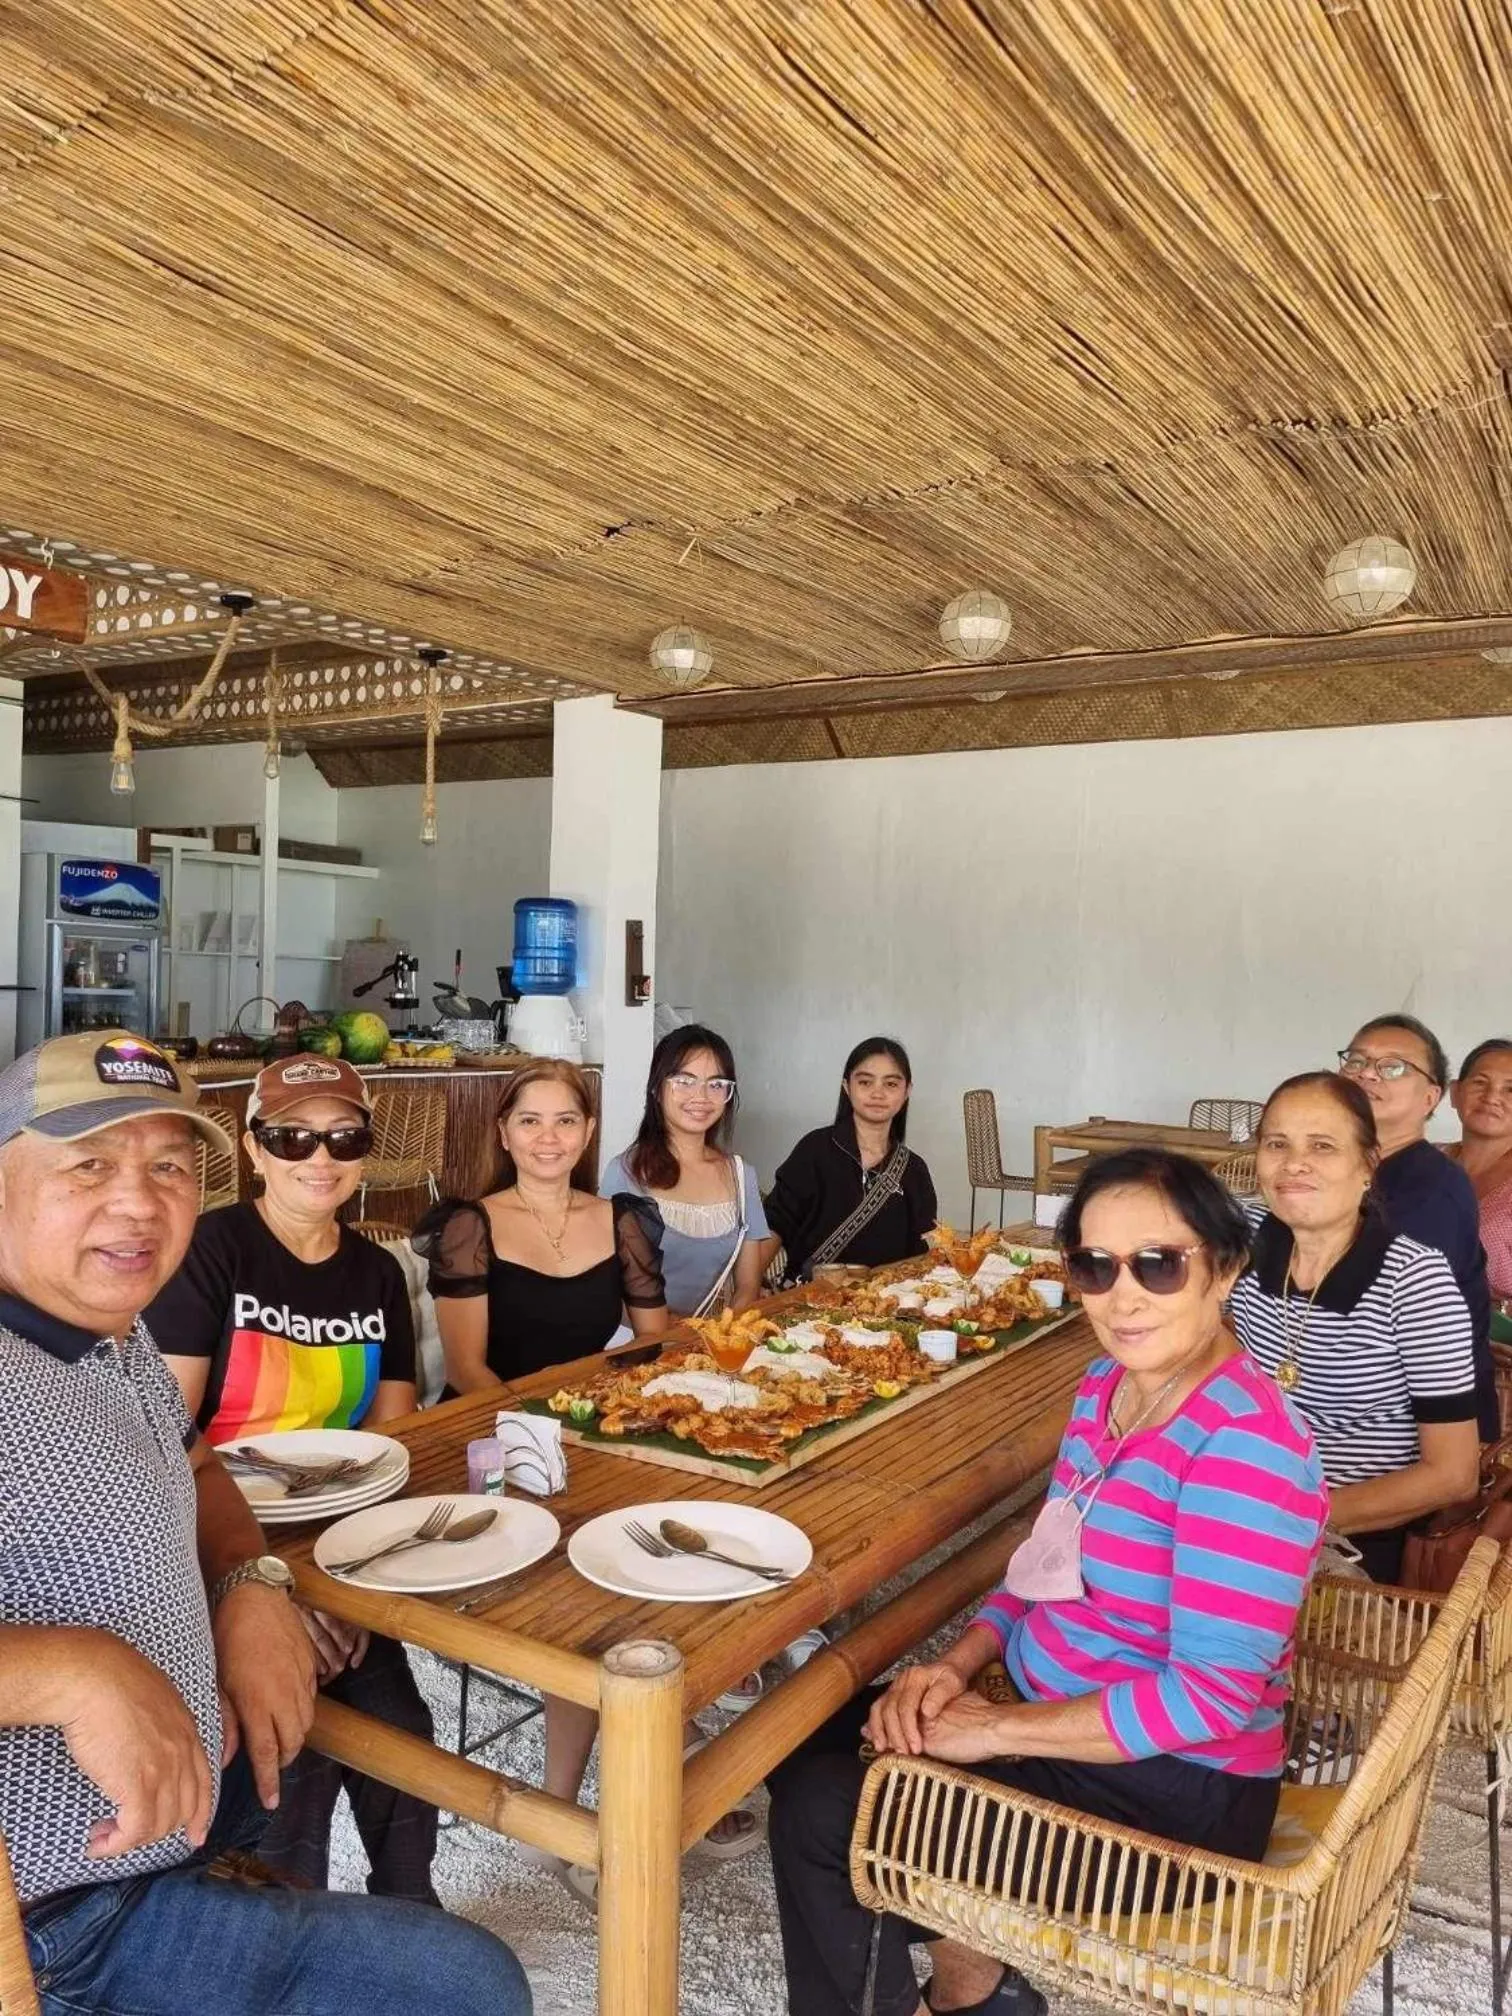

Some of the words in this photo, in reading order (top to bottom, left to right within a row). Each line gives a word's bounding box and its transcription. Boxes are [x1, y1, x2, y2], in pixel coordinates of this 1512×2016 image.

[0, 564, 43, 619] Y
[62, 865, 118, 880] FUJIDENZO
[101, 1060, 174, 1082] YOSEMITE
[235, 1293, 386, 1343] Polaroid
